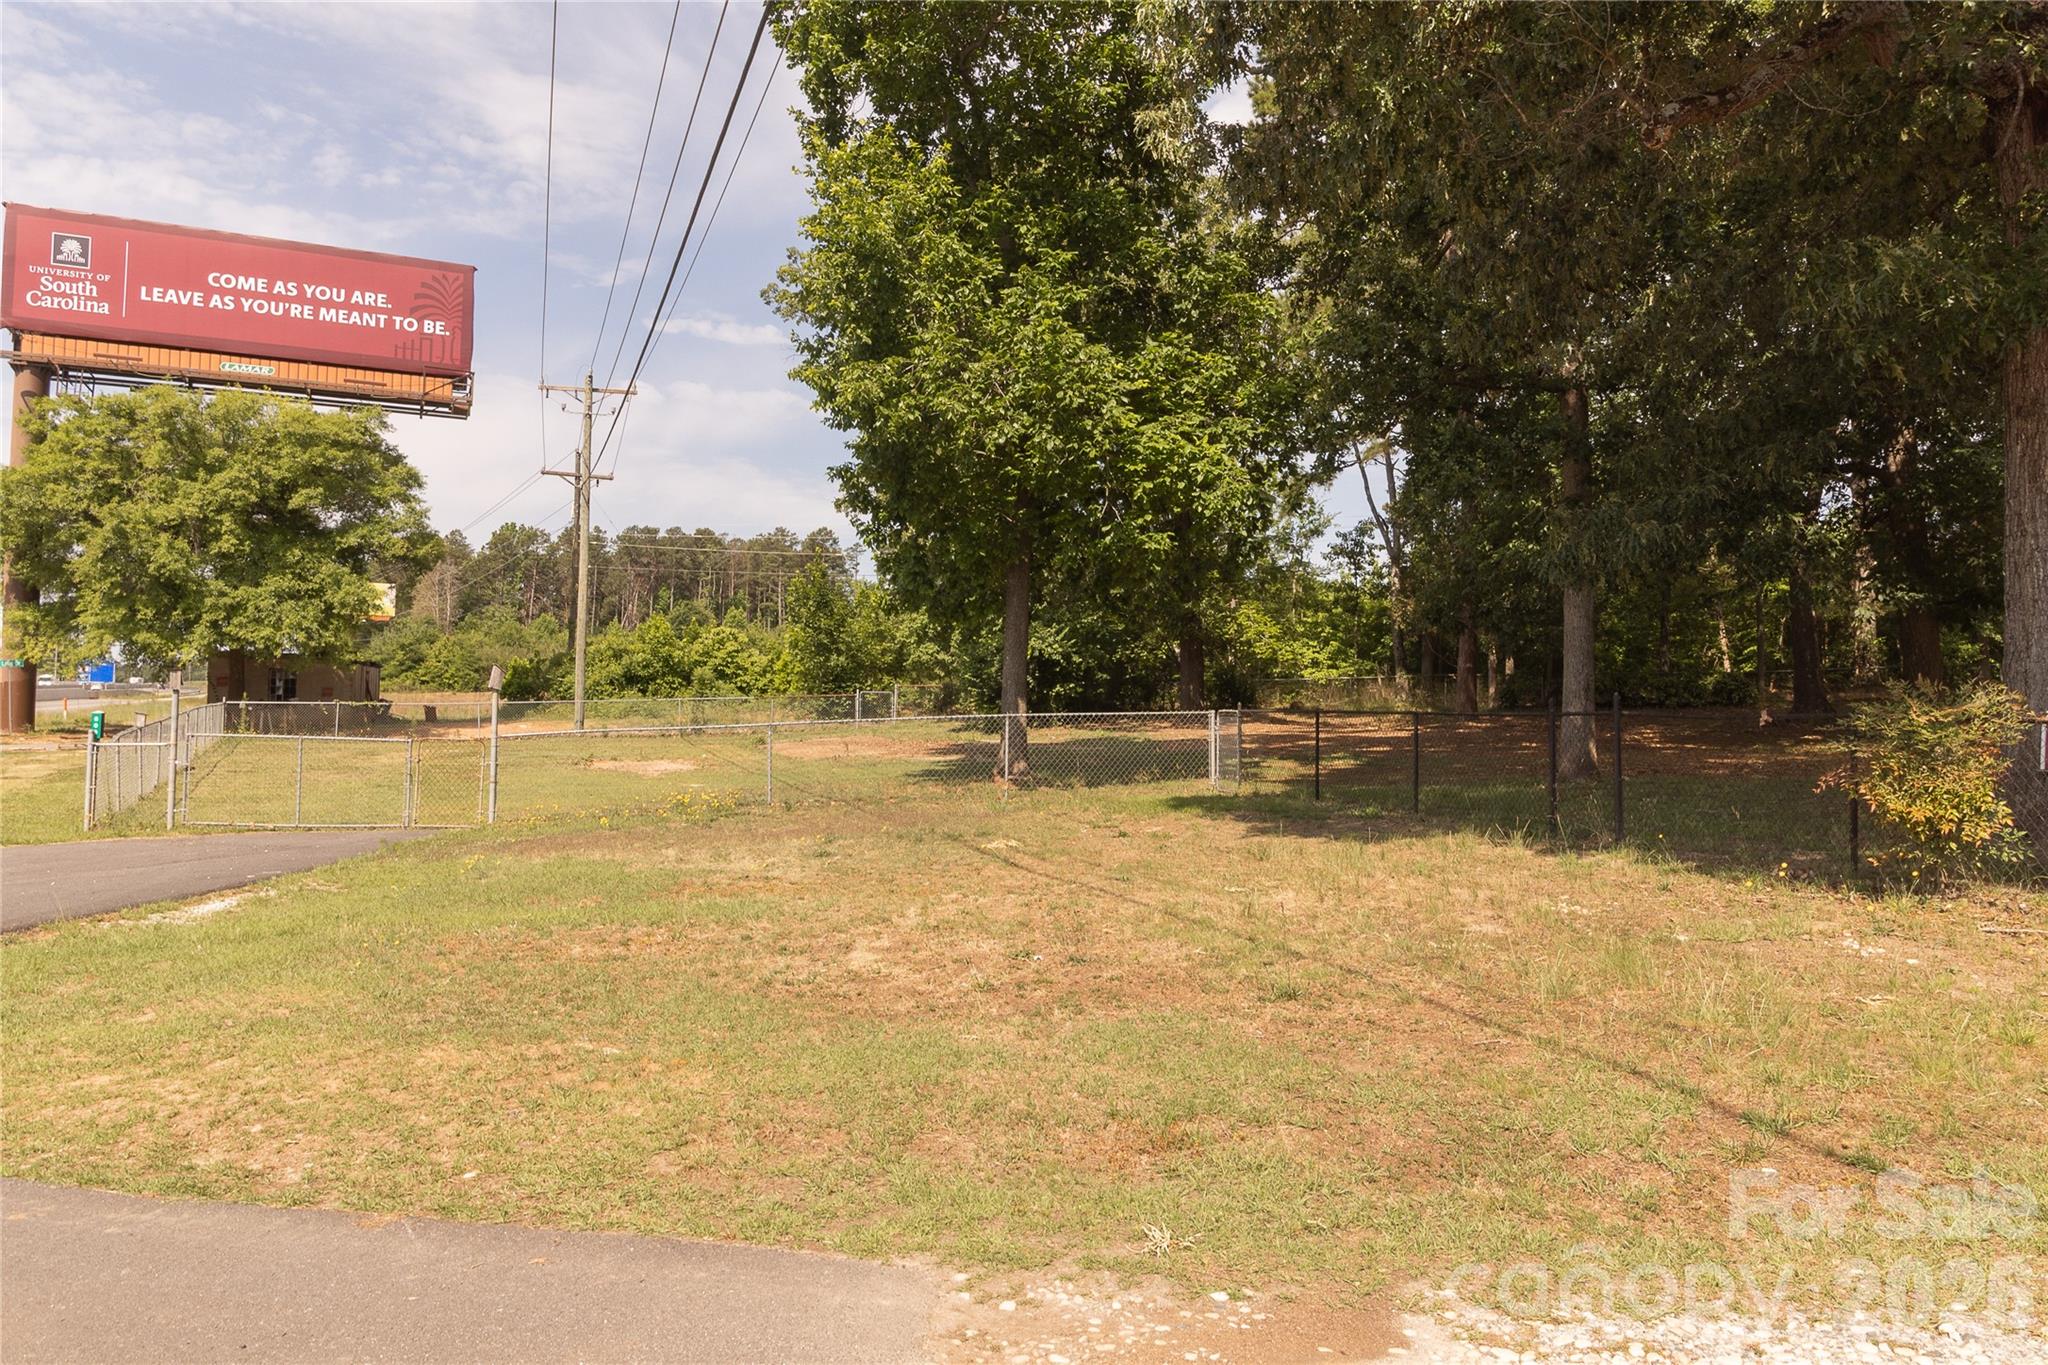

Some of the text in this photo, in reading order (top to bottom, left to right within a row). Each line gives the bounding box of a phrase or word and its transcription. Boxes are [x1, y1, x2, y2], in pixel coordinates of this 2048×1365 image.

[29, 265, 111, 282] UNIVERSITY OF
[40, 276, 97, 297] South
[208, 272, 392, 308] COME AS YOU ARE.
[26, 290, 110, 315] Carolina
[140, 286, 450, 336] LEAVE AS YOU'RE MEANT TO BE.
[224, 362, 270, 375] LAMAR
